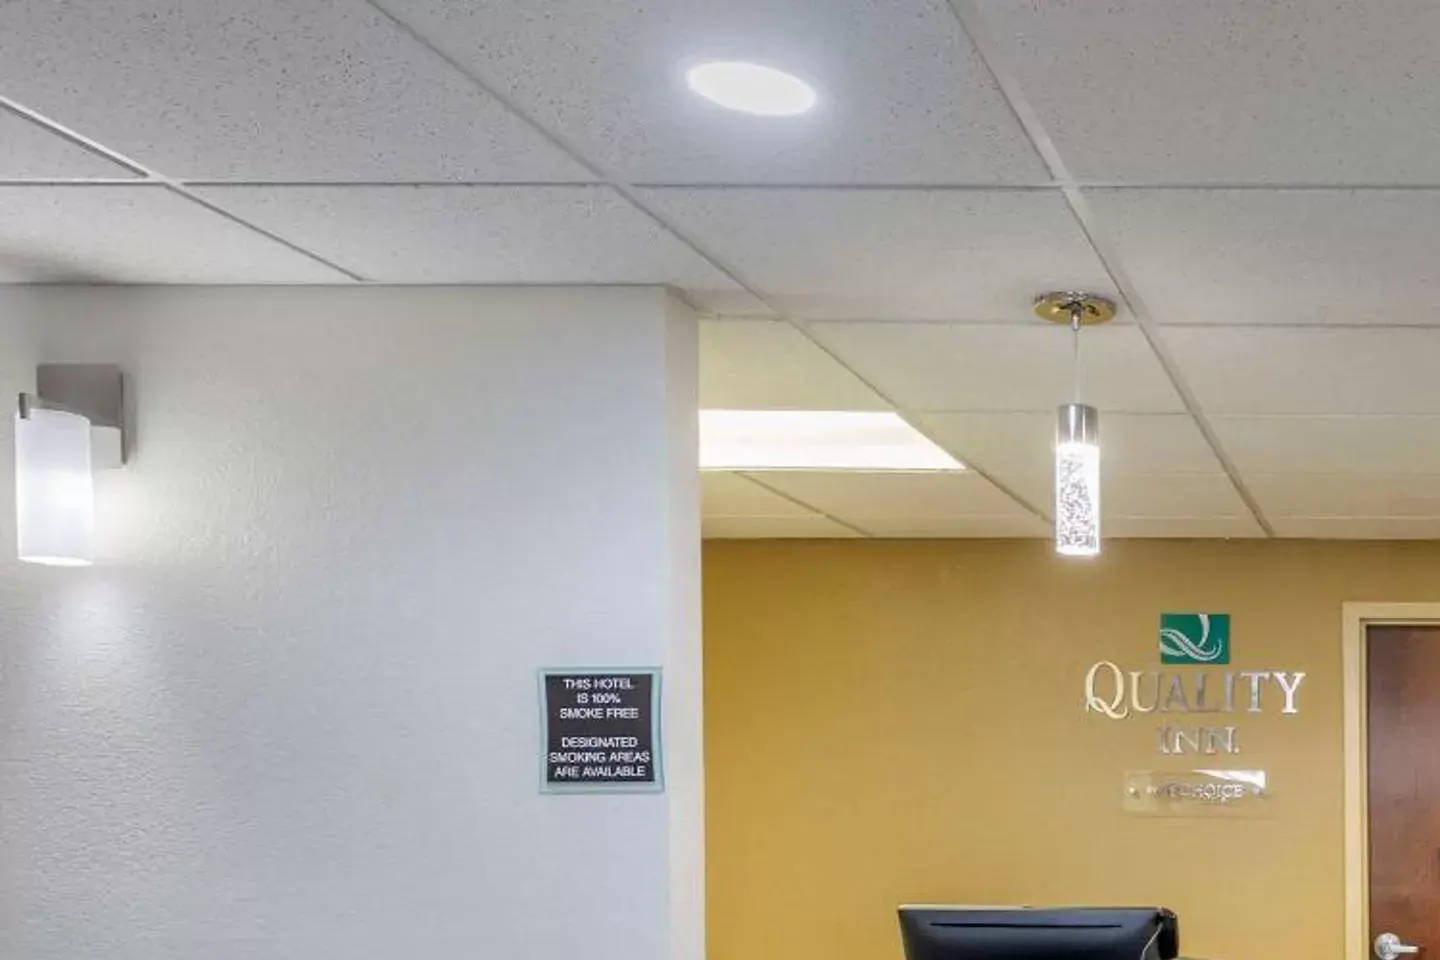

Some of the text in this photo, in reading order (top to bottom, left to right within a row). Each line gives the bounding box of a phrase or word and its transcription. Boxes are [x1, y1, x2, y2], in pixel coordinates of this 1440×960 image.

[563, 678, 634, 690] THIS HOTEL
[1084, 660, 1307, 719] QUALITY
[576, 692, 621, 704] IS 100%
[560, 708, 639, 719] SMOKE FREE
[561, 736, 639, 748] DESIGNATED
[549, 751, 650, 763] SMOKING AREAS
[554, 765, 646, 778] ARE AVAILABLE
